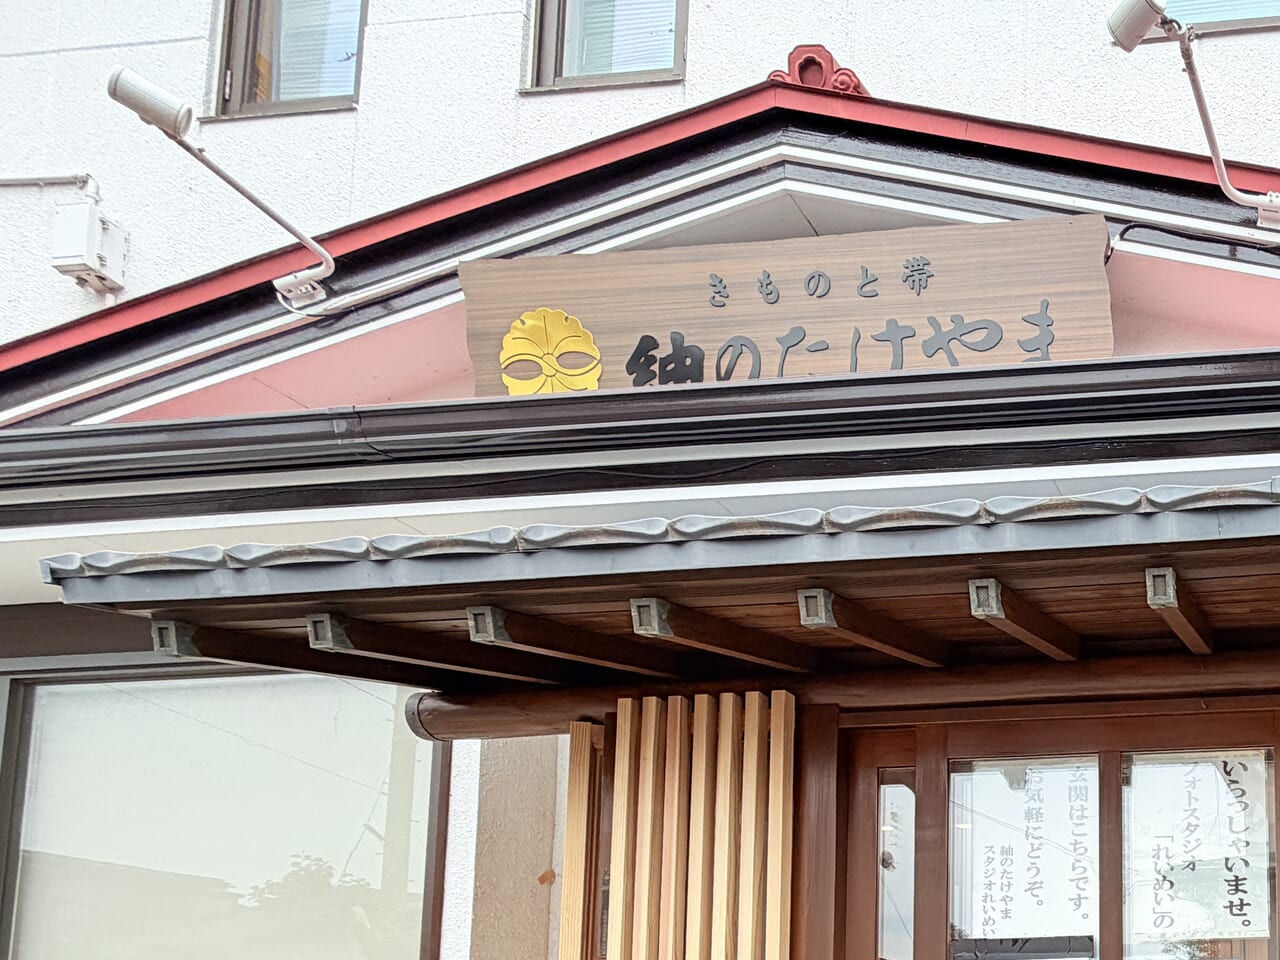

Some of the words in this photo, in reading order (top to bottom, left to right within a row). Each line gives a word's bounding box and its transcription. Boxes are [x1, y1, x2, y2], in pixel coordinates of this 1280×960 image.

[706, 255, 935, 307] きものと帯
[625, 298, 1057, 387] 紬のたけやま
[1024, 767, 1044, 907] お気軽にどうぞ。
[1068, 766, 1090, 920] 玄関はこちらです。
[982, 845, 997, 938] スタジオれいめい
[999, 846, 1014, 920] 紬のたけやま
